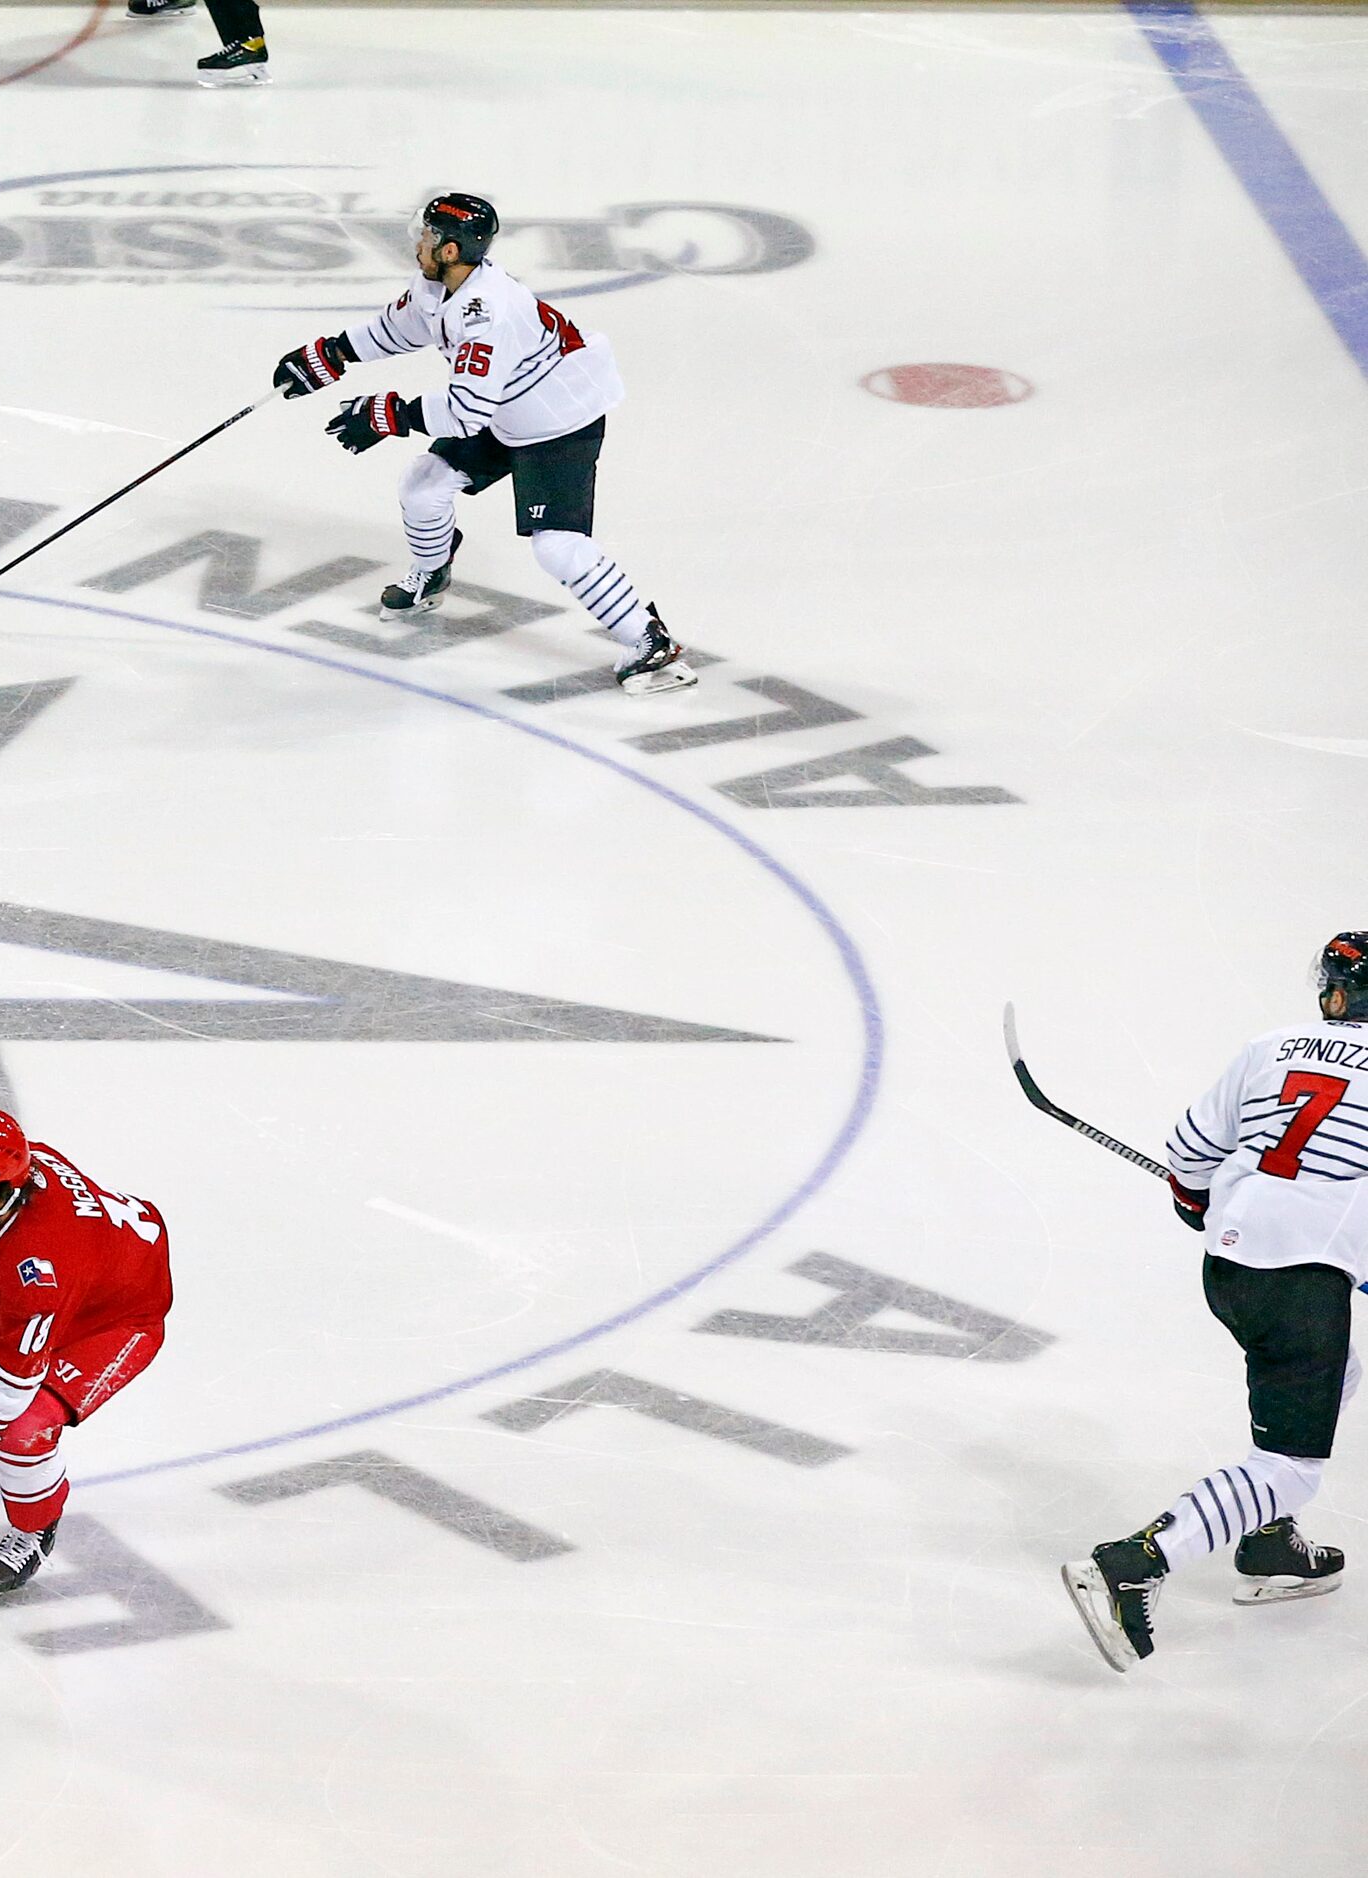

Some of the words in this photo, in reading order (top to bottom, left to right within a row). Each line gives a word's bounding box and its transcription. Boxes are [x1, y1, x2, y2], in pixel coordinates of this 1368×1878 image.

[454, 342, 493, 377] 25
[1072, 1120, 1170, 1181] WARRIOR
[1256, 1070, 1351, 1181] 7
[19, 1313, 55, 1355] 18
